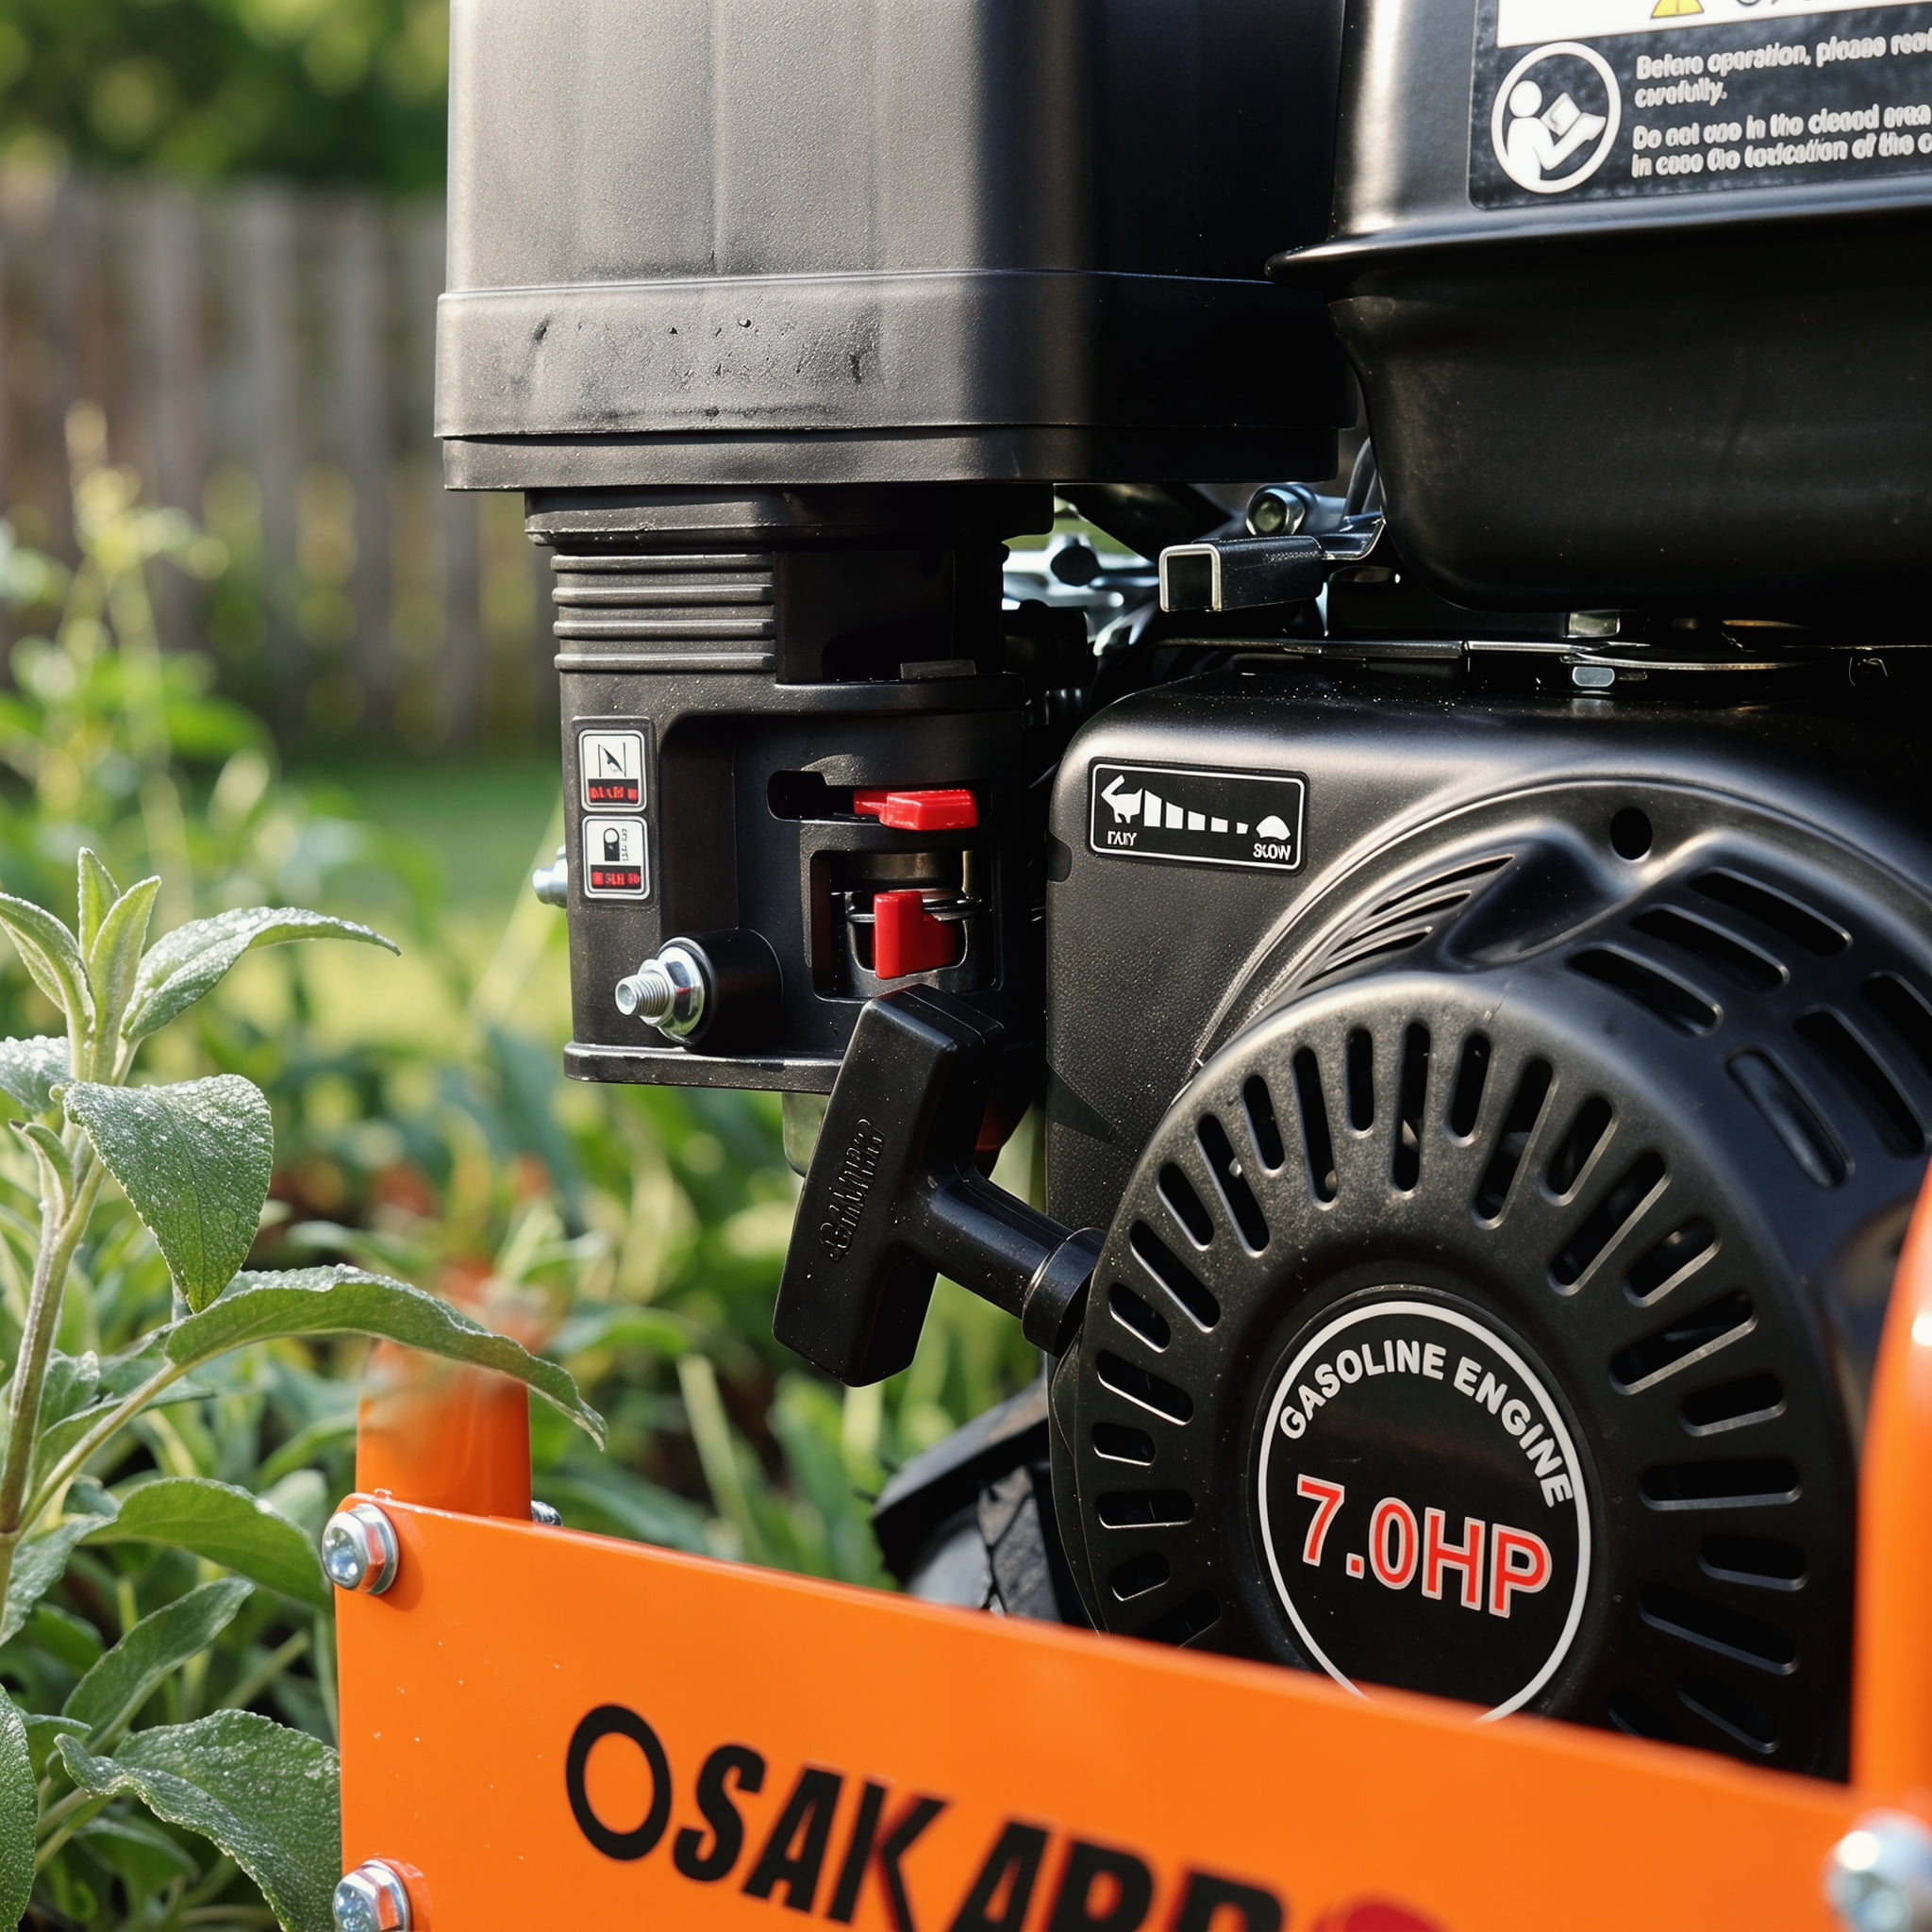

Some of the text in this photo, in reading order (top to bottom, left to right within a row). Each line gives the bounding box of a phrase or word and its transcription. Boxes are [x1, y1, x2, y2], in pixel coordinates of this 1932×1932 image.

[1279, 1340, 1574, 1508] GASOLINE ENGINE
[1296, 1473, 1553, 1619] 7.0HP
